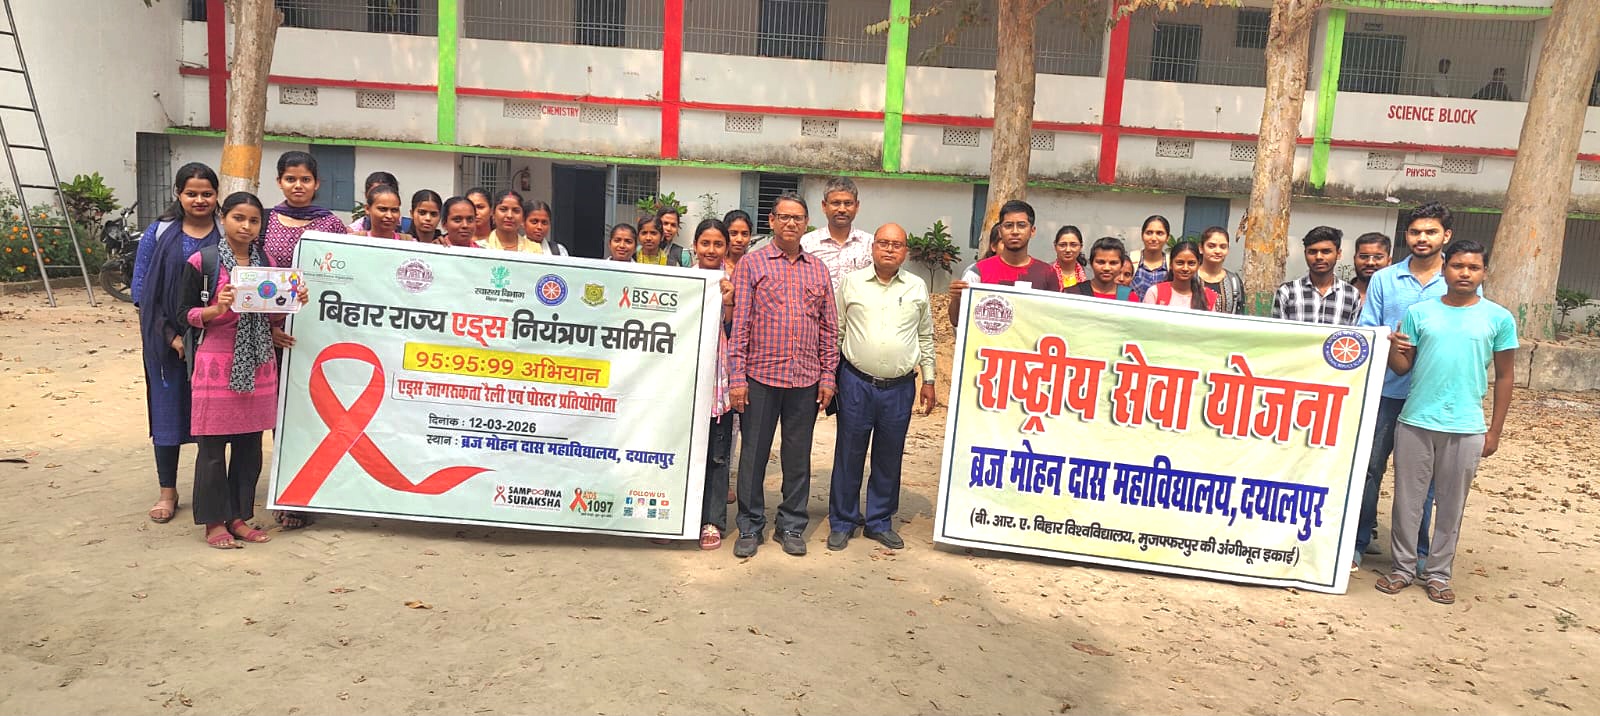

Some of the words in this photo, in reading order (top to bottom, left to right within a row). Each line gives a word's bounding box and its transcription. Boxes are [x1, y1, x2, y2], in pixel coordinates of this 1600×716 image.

[541, 105, 579, 117] CHEMISTRY
[1387, 104, 1435, 121] SCIENCE
[1438, 108, 1478, 124] BLOCK
[1405, 167, 1437, 178] PHYSICS
[632, 290, 678, 307] BSACS
[318, 291, 387, 327] बिहार
[388, 306, 448, 333] राज्य
[451, 311, 508, 347] एड्स
[511, 308, 599, 347] नियंत्रण
[600, 319, 676, 354] समिति
[415, 351, 515, 374] 95:95:99
[520, 360, 602, 384] अभियान
[397, 379, 424, 400] एड्स
[483, 383, 505, 403] रैली
[507, 385, 528, 406] एवं
[527, 387, 558, 408] पोस्टर
[558, 391, 618, 414] प्रतियोगिता
[977, 336, 1105, 433] राष्ट्रीय
[1112, 343, 1199, 432] सेवा
[1205, 354, 1349, 447] योजना
[428, 413, 459, 427] दिनांक
[468, 416, 537, 434] 12-03-2026
[427, 434, 452, 447] स्थान
[461, 435, 484, 450] ब्रज
[485, 434, 518, 453] मोहन
[520, 439, 545, 455] दास
[547, 441, 622, 464] महाविद्यालय,
[625, 449, 676, 469] दयालपुर
[969, 446, 1008, 490] ब्रज
[1010, 439, 1065, 497] मोहन
[1068, 457, 1111, 502] दास
[507, 495, 561, 508] SURAKSHA
[628, 489, 656, 498] FOLLOW
[587, 500, 614, 513] 1097
[1033, 514, 1064, 535] बिहार
[1199, 537, 1218, 554] की
[1217, 540, 1261, 565] अंगीभूत
[1262, 546, 1301, 567] इकाई)
